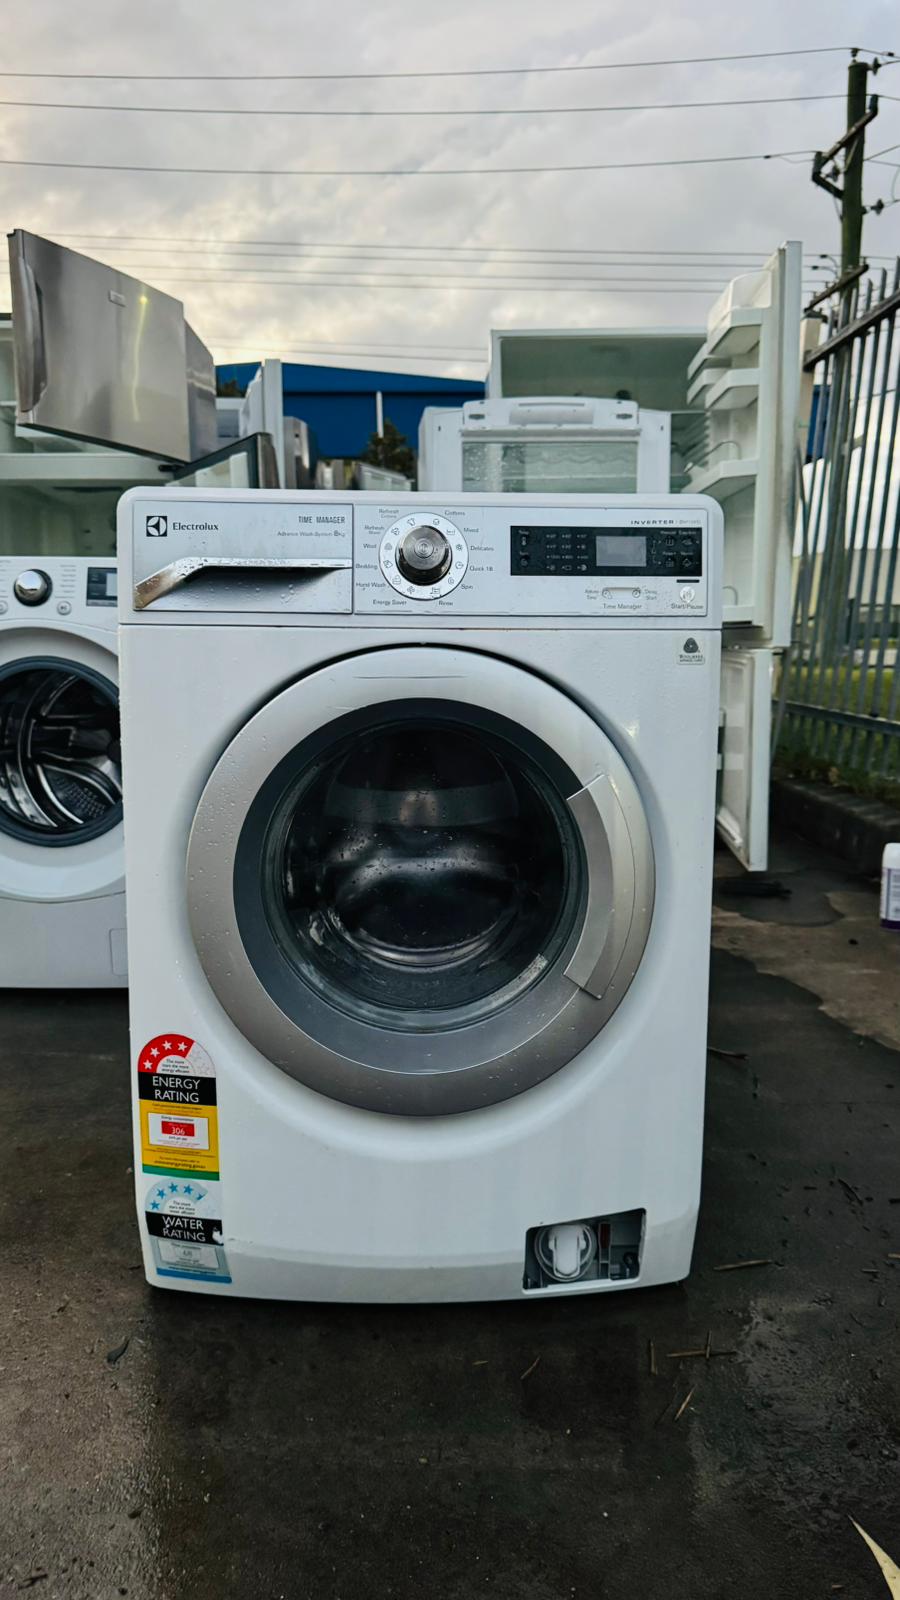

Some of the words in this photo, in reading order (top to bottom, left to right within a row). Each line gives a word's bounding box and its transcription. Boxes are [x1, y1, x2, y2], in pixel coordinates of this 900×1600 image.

[172, 522, 219, 531] Electrolux
[316, 516, 346, 524] MANAGER
[152, 1076, 200, 1090] ENERGY
[154, 1089, 200, 1103] RATING
[172, 1126, 185, 1136] 306
[162, 1216, 204, 1230] WATER
[162, 1228, 206, 1242] RATING
